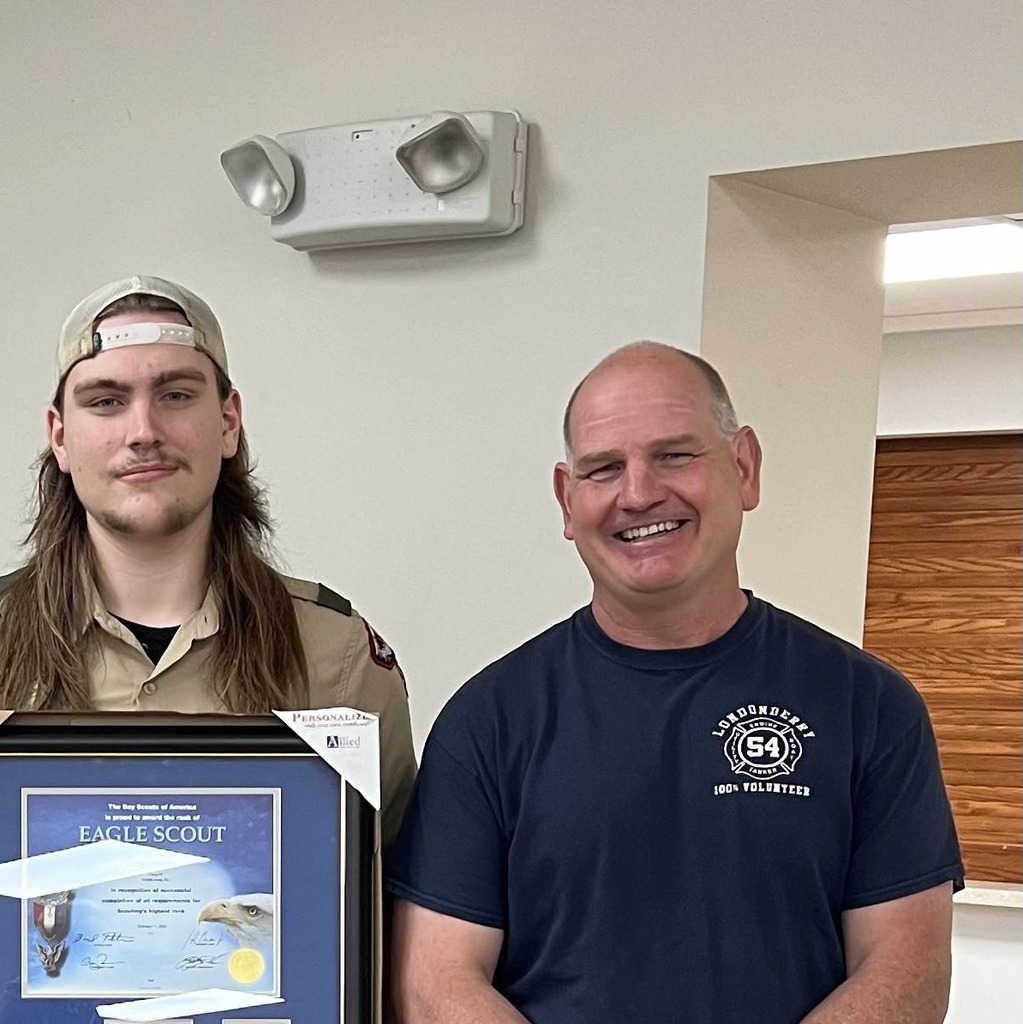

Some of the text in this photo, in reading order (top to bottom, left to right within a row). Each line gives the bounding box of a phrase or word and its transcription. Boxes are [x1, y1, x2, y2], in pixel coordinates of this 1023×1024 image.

[712, 704, 815, 738] LONDONDERRY
[327, 736, 361, 748] Allied
[746, 736, 780, 758] 54
[789, 738, 797, 760] BOAT
[748, 767, 778, 775] TANKER
[714, 782, 810, 796] 100% VOLUNTEER
[122, 803, 136, 811] Boy
[79, 825, 227, 843] EAGLE SCOUT
